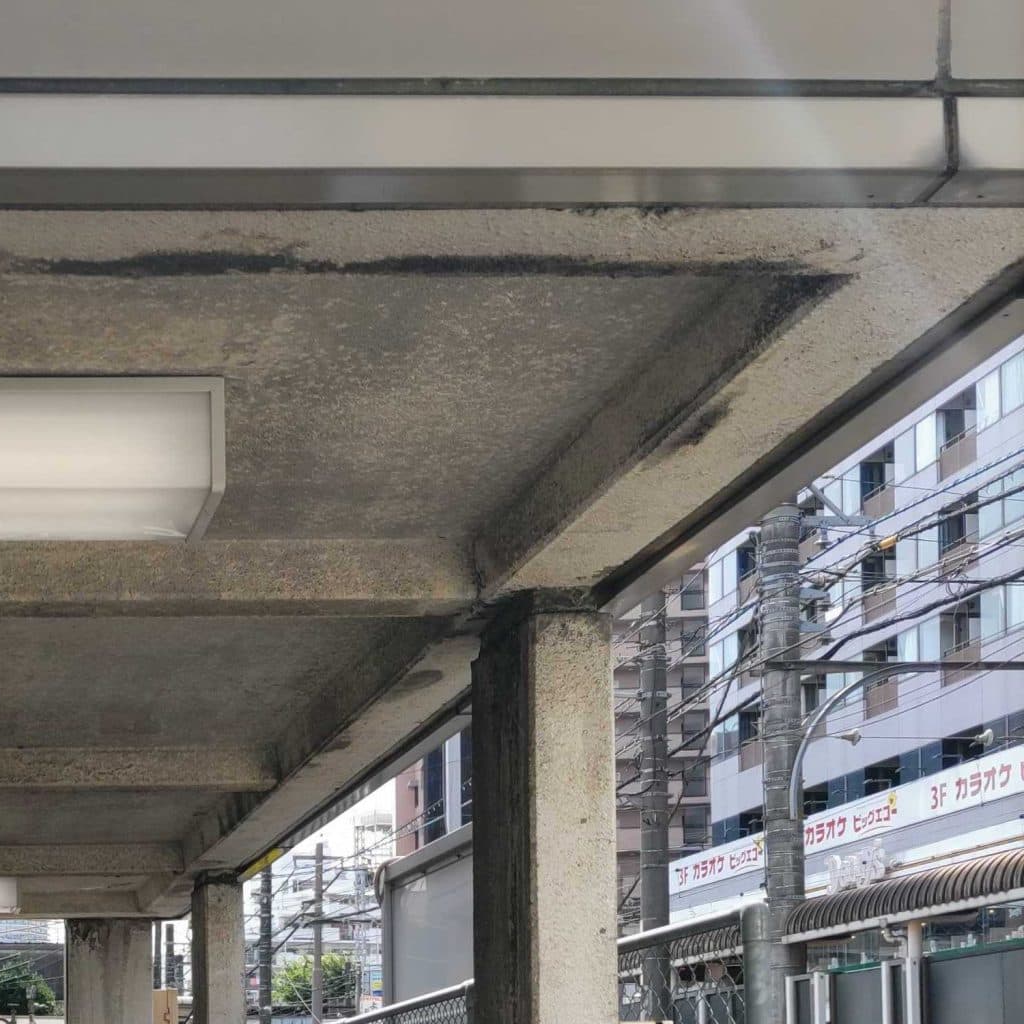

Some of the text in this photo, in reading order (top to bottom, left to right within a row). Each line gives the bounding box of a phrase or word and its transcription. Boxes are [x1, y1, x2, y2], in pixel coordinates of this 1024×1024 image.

[930, 782, 947, 810] 3F
[956, 763, 1012, 801] カラオケ
[805, 804, 898, 845] カラオケ ビッグエコー
[693, 855, 725, 881] カラオケ
